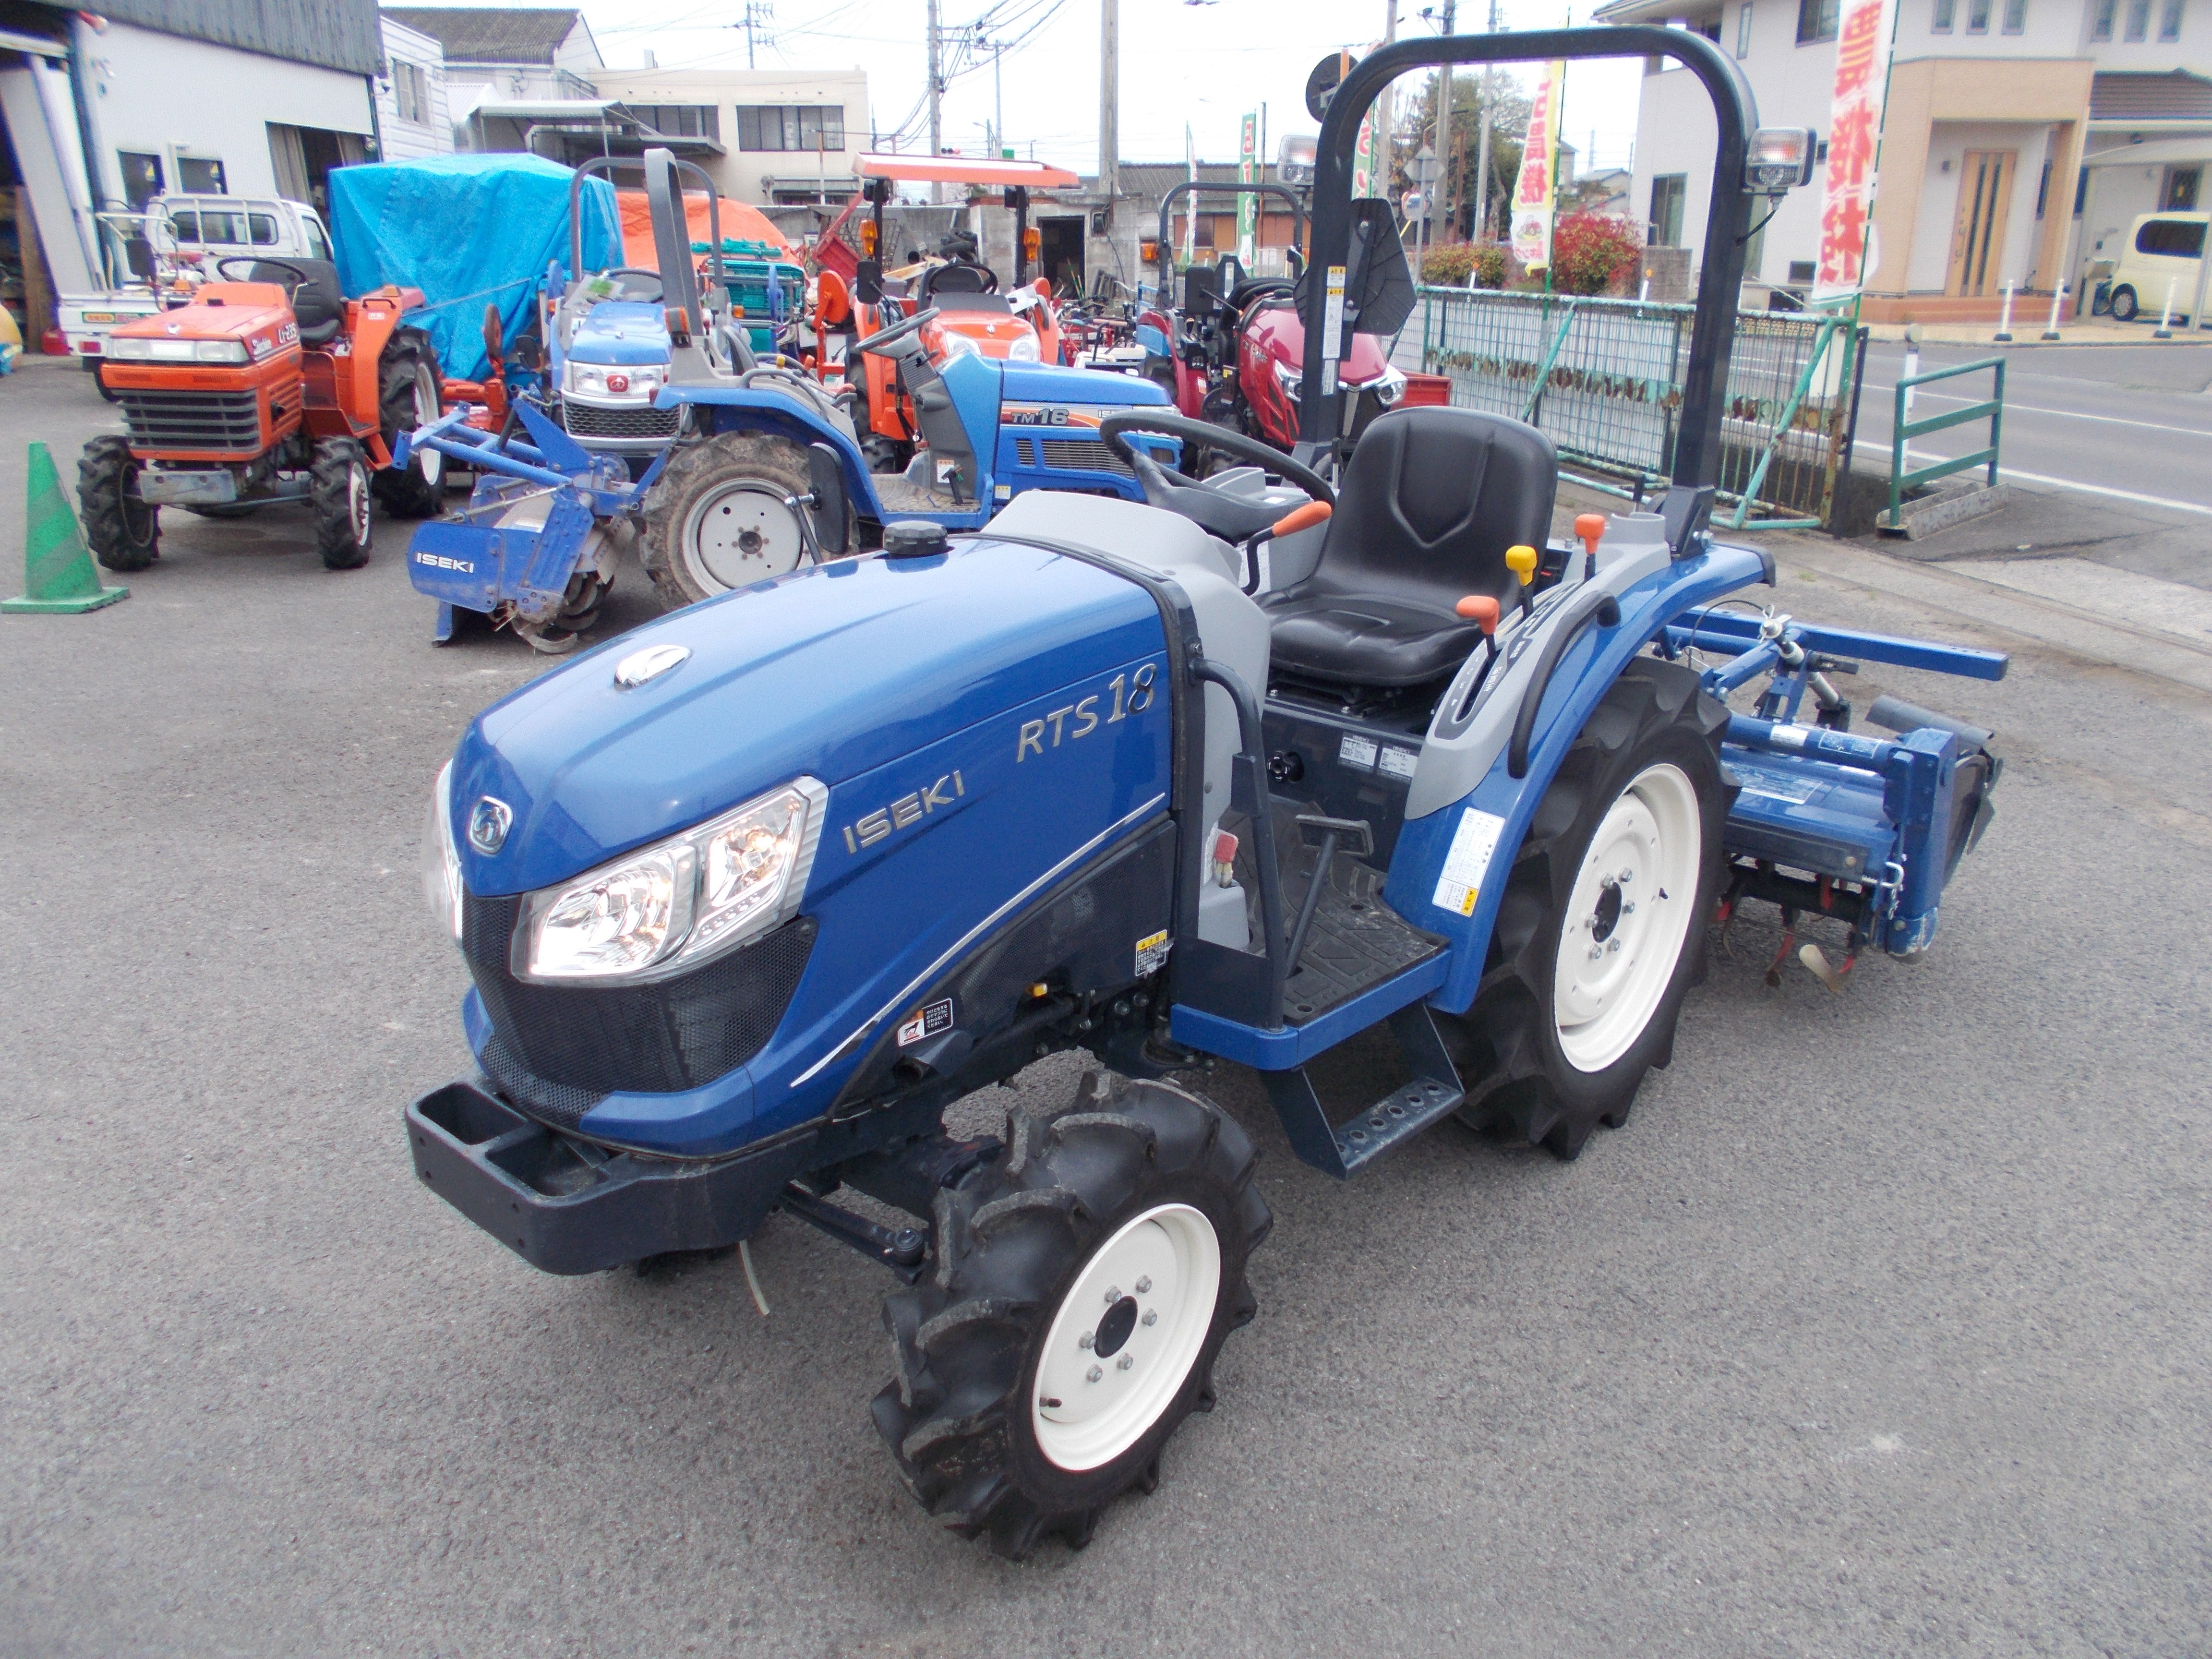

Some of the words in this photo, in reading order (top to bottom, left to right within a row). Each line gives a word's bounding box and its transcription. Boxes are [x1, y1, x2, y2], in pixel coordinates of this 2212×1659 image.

[1010, 408, 1070, 425] TM16
[416, 552, 474, 573] ISEKI
[1352, 735, 1370, 743] ISEKI
[1393, 745, 1410, 754] ISEKI
[842, 770, 965, 854] ISEKI
[926, 1004, 948, 1015] やけどをする
